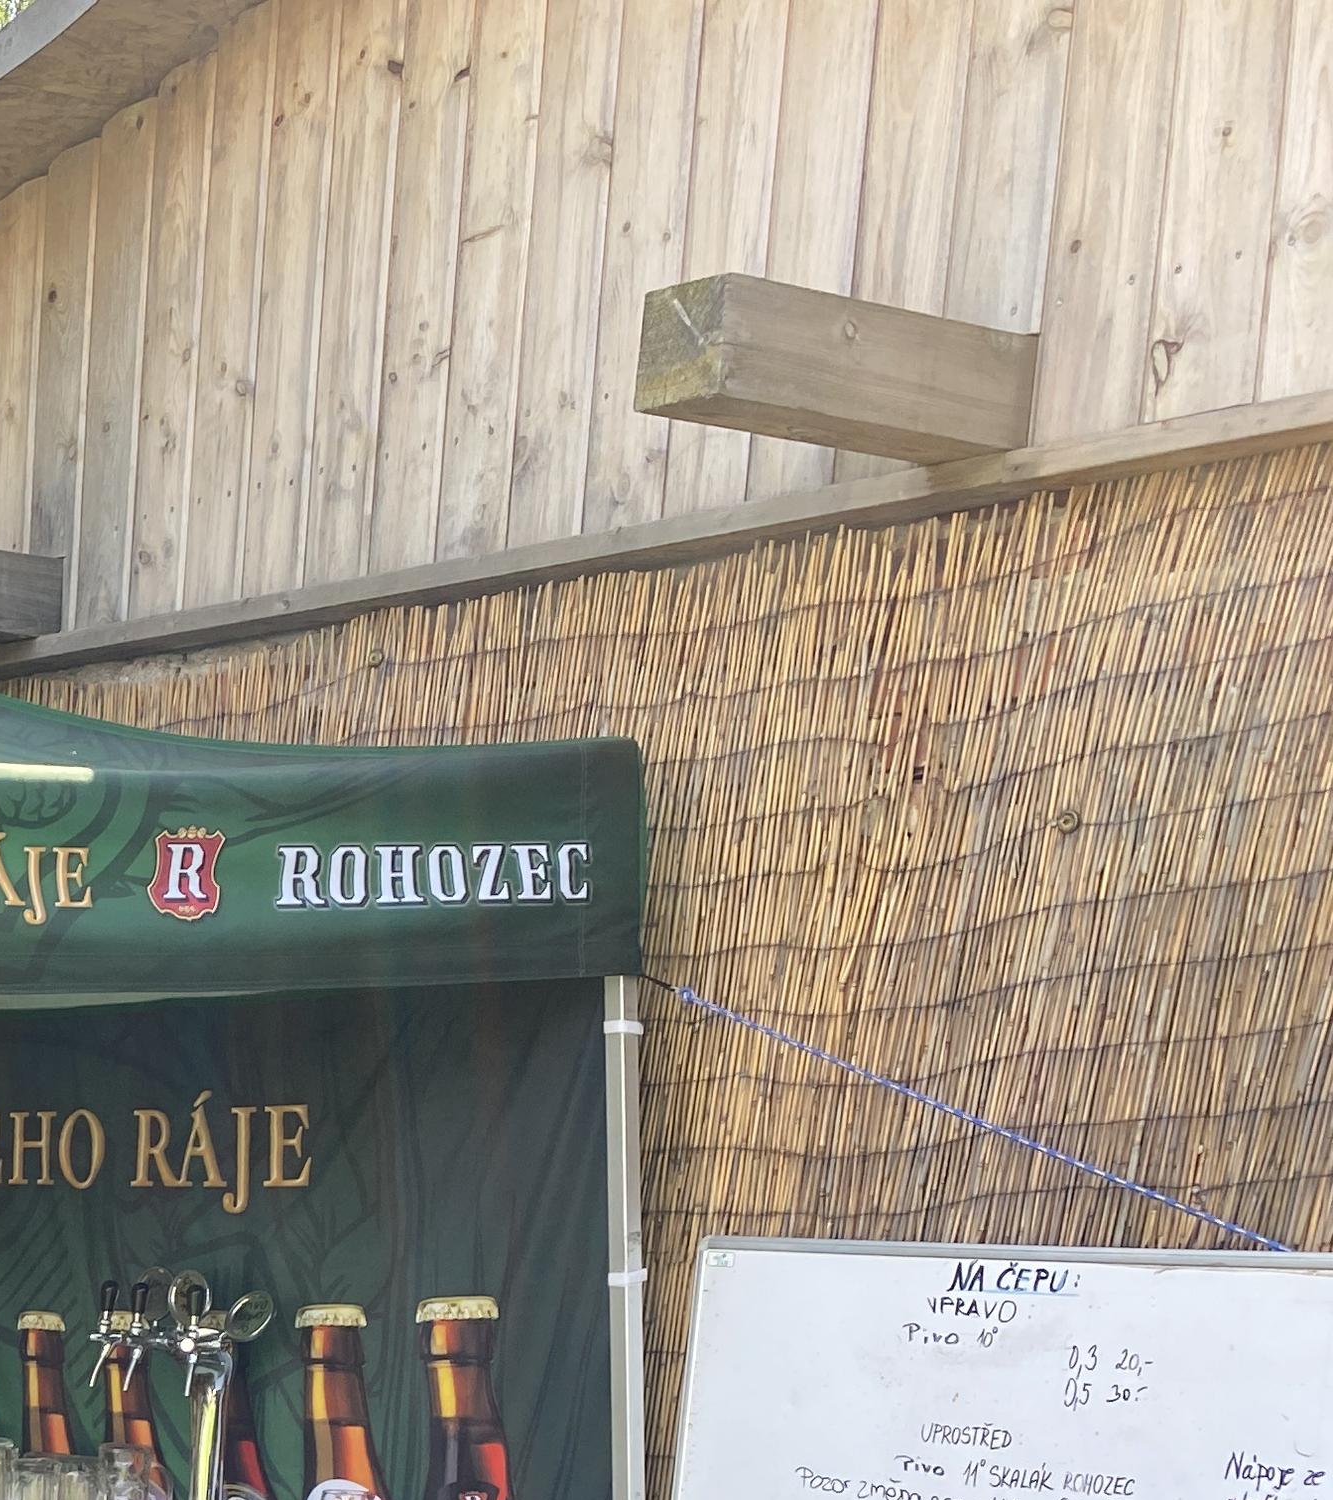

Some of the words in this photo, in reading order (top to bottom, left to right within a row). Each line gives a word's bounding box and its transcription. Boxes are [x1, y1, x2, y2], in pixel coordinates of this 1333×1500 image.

[164, 842, 209, 903] R
[275, 842, 590, 908] ROHOZEC
[130, 1090, 312, 1214] RÁJE
[946, 1259, 985, 1292] NA
[902, 1322, 959, 1345] Pivo
[1068, 1344, 1098, 1380] 0,3
[1063, 1377, 1093, 1412] 0,5
[894, 1454, 945, 1476] Pivo
[989, 1462, 1054, 1492] SKALÁK
[1063, 1471, 1136, 1496] ROHOZEC
[1224, 1450, 1295, 1492] Nápoje
